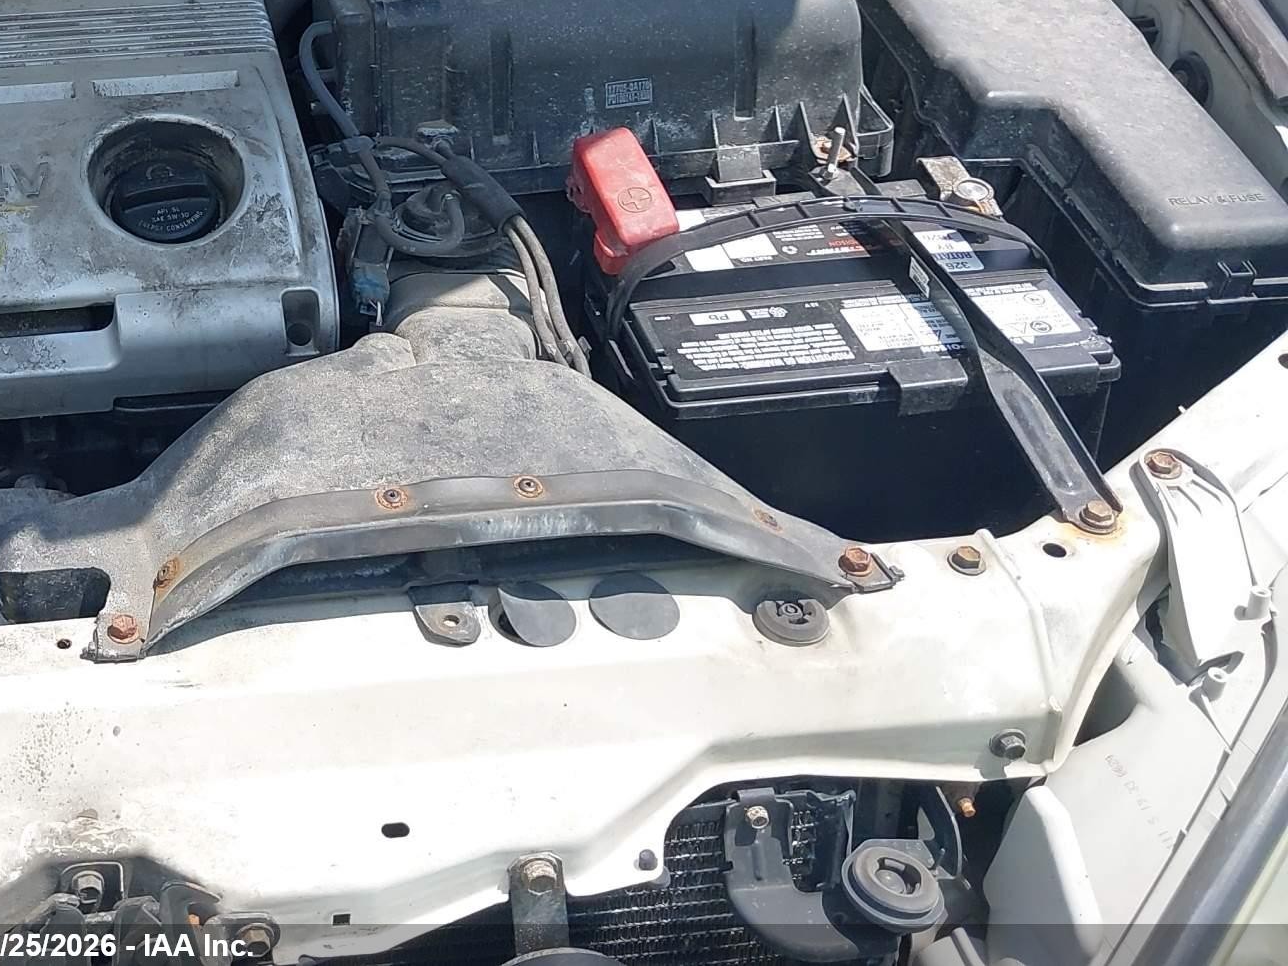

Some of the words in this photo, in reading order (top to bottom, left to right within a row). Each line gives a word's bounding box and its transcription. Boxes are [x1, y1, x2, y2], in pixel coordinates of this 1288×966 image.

[1168, 196, 1212, 206] RELAY
[1228, 193, 1265, 203] FUSE
[945, 261, 970, 270] 326
